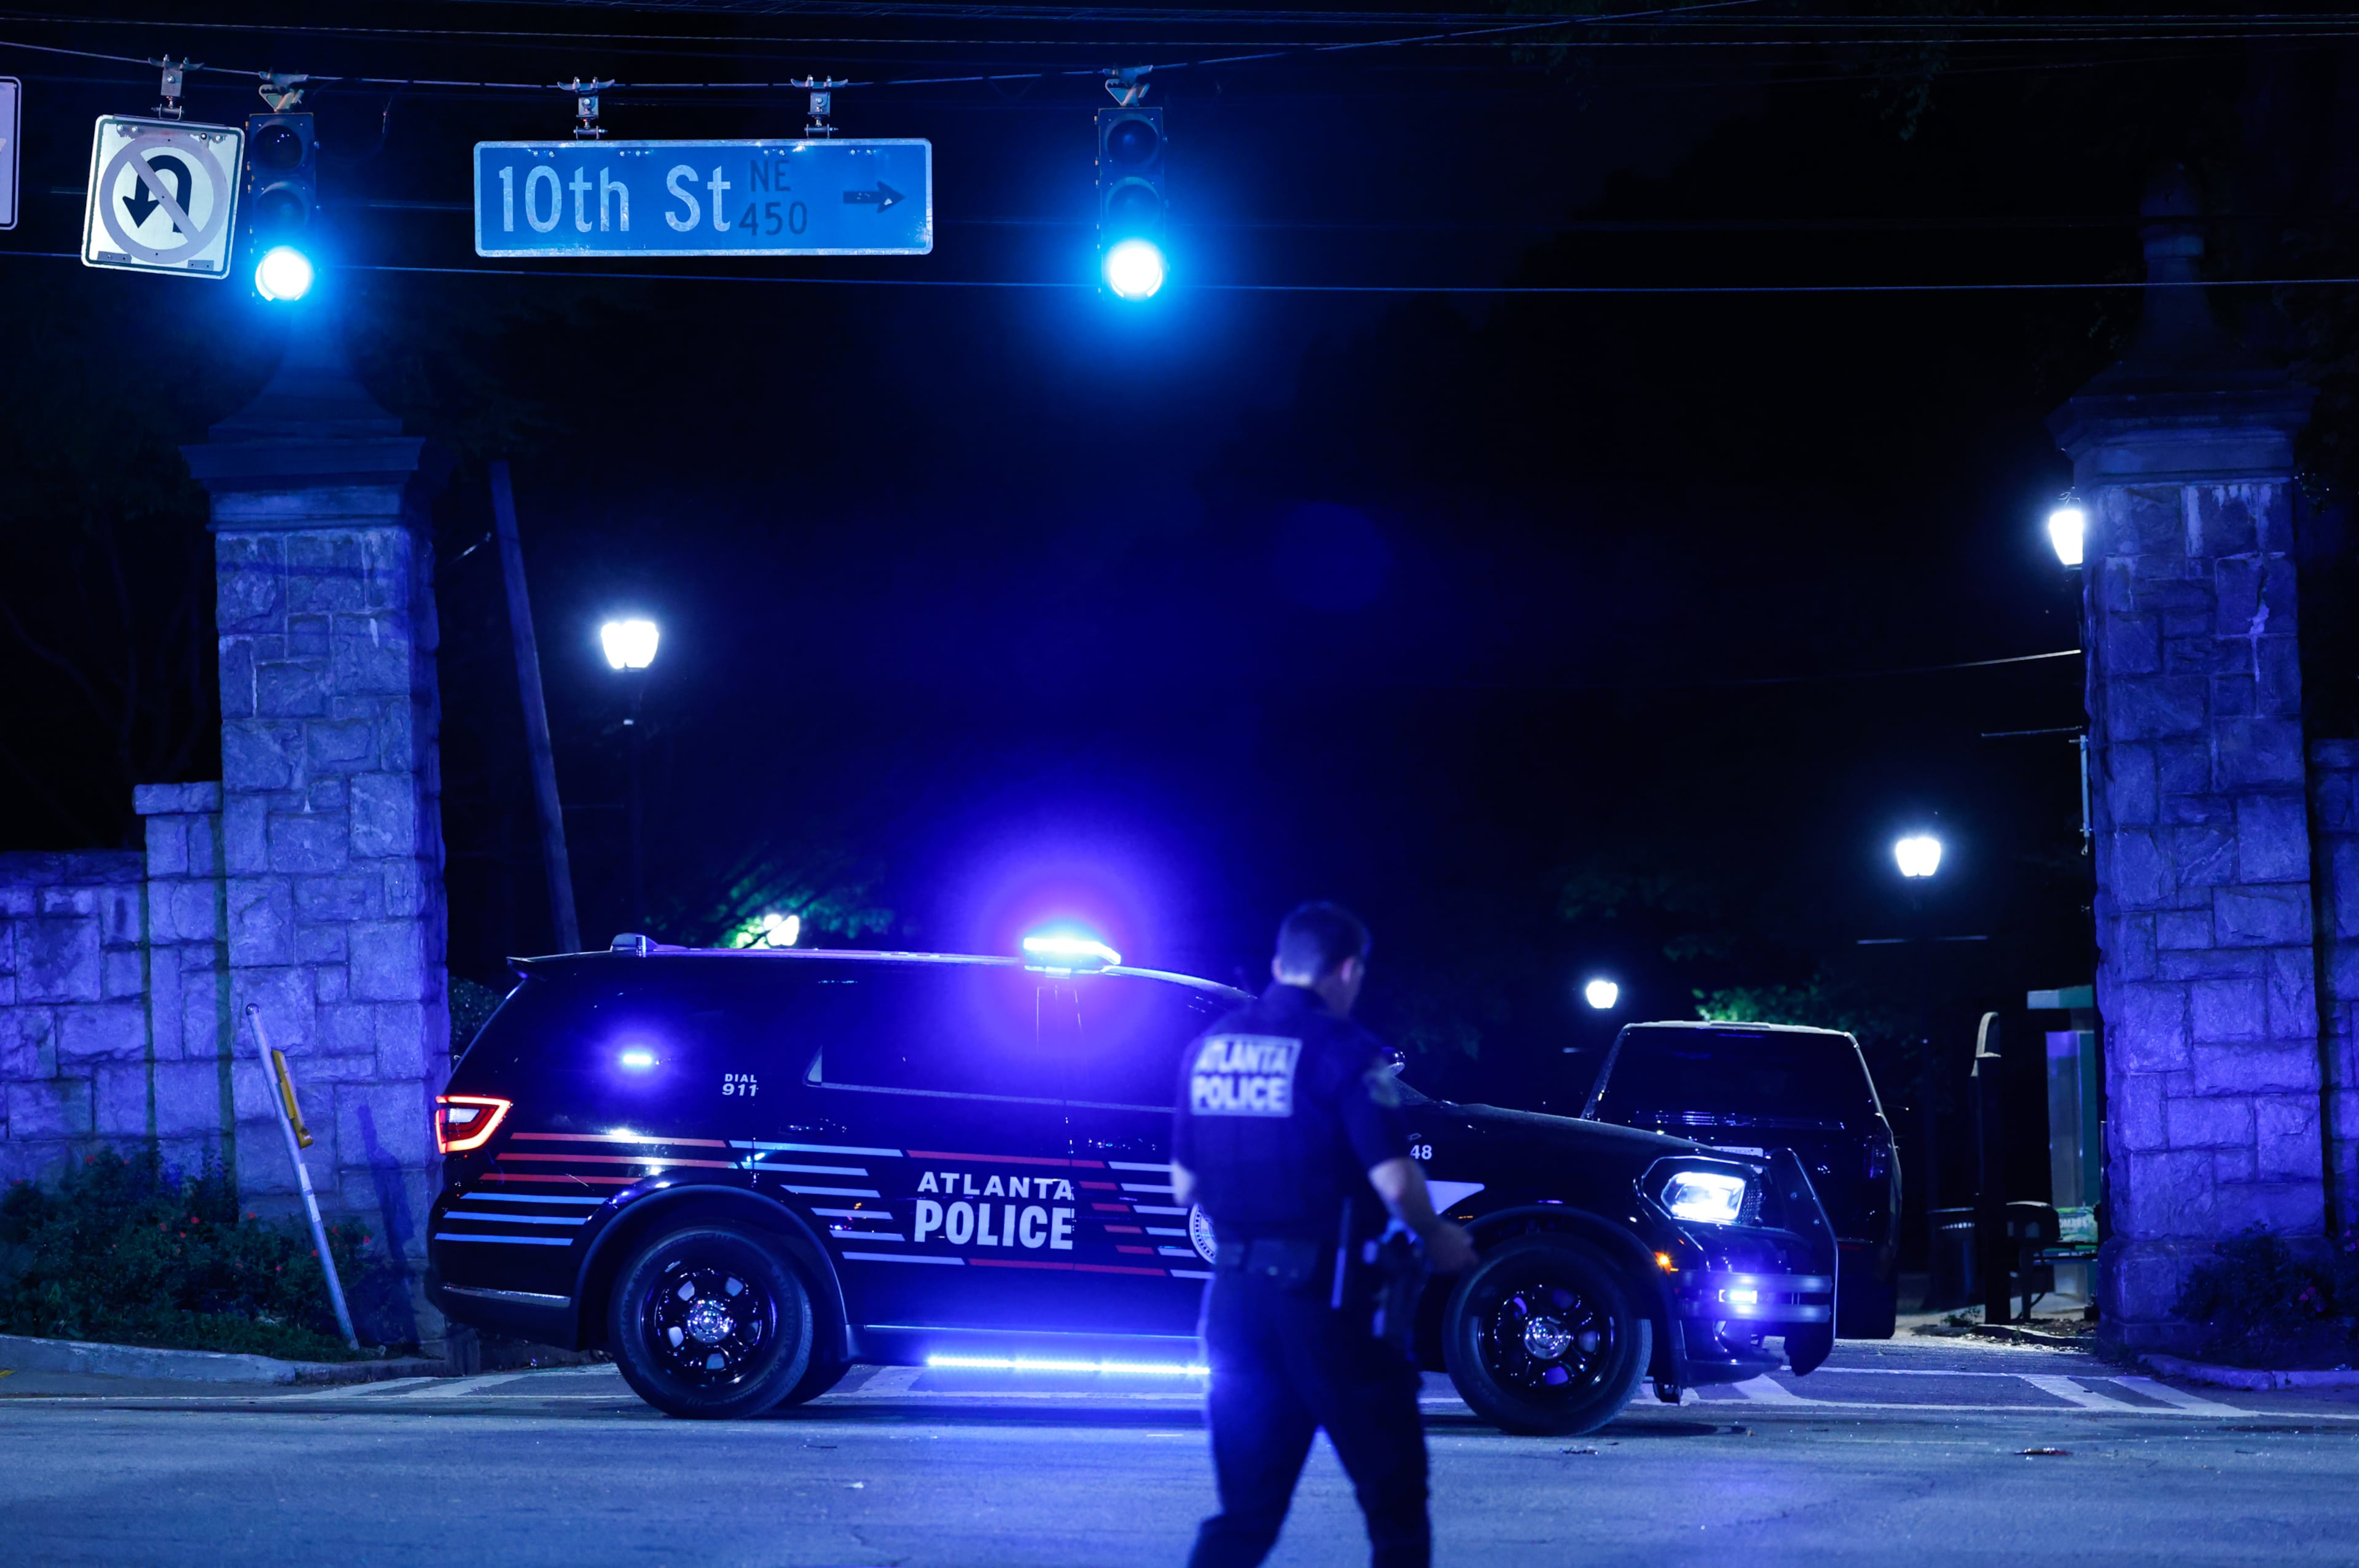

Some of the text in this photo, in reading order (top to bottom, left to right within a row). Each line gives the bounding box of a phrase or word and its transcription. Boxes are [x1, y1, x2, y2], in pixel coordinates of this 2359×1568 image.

[749, 159, 792, 192] NE
[498, 164, 731, 232] 10th St
[738, 201, 808, 236] 450
[1195, 1040, 1288, 1072] ATLANTA
[722, 1083, 757, 1097] 911
[724, 1073, 757, 1083] DIAL
[1192, 1075, 1288, 1110] POLICE
[1410, 1144, 1433, 1160] 48
[917, 1171, 1075, 1201] ATLANTA
[914, 1199, 1075, 1250] POLICE
